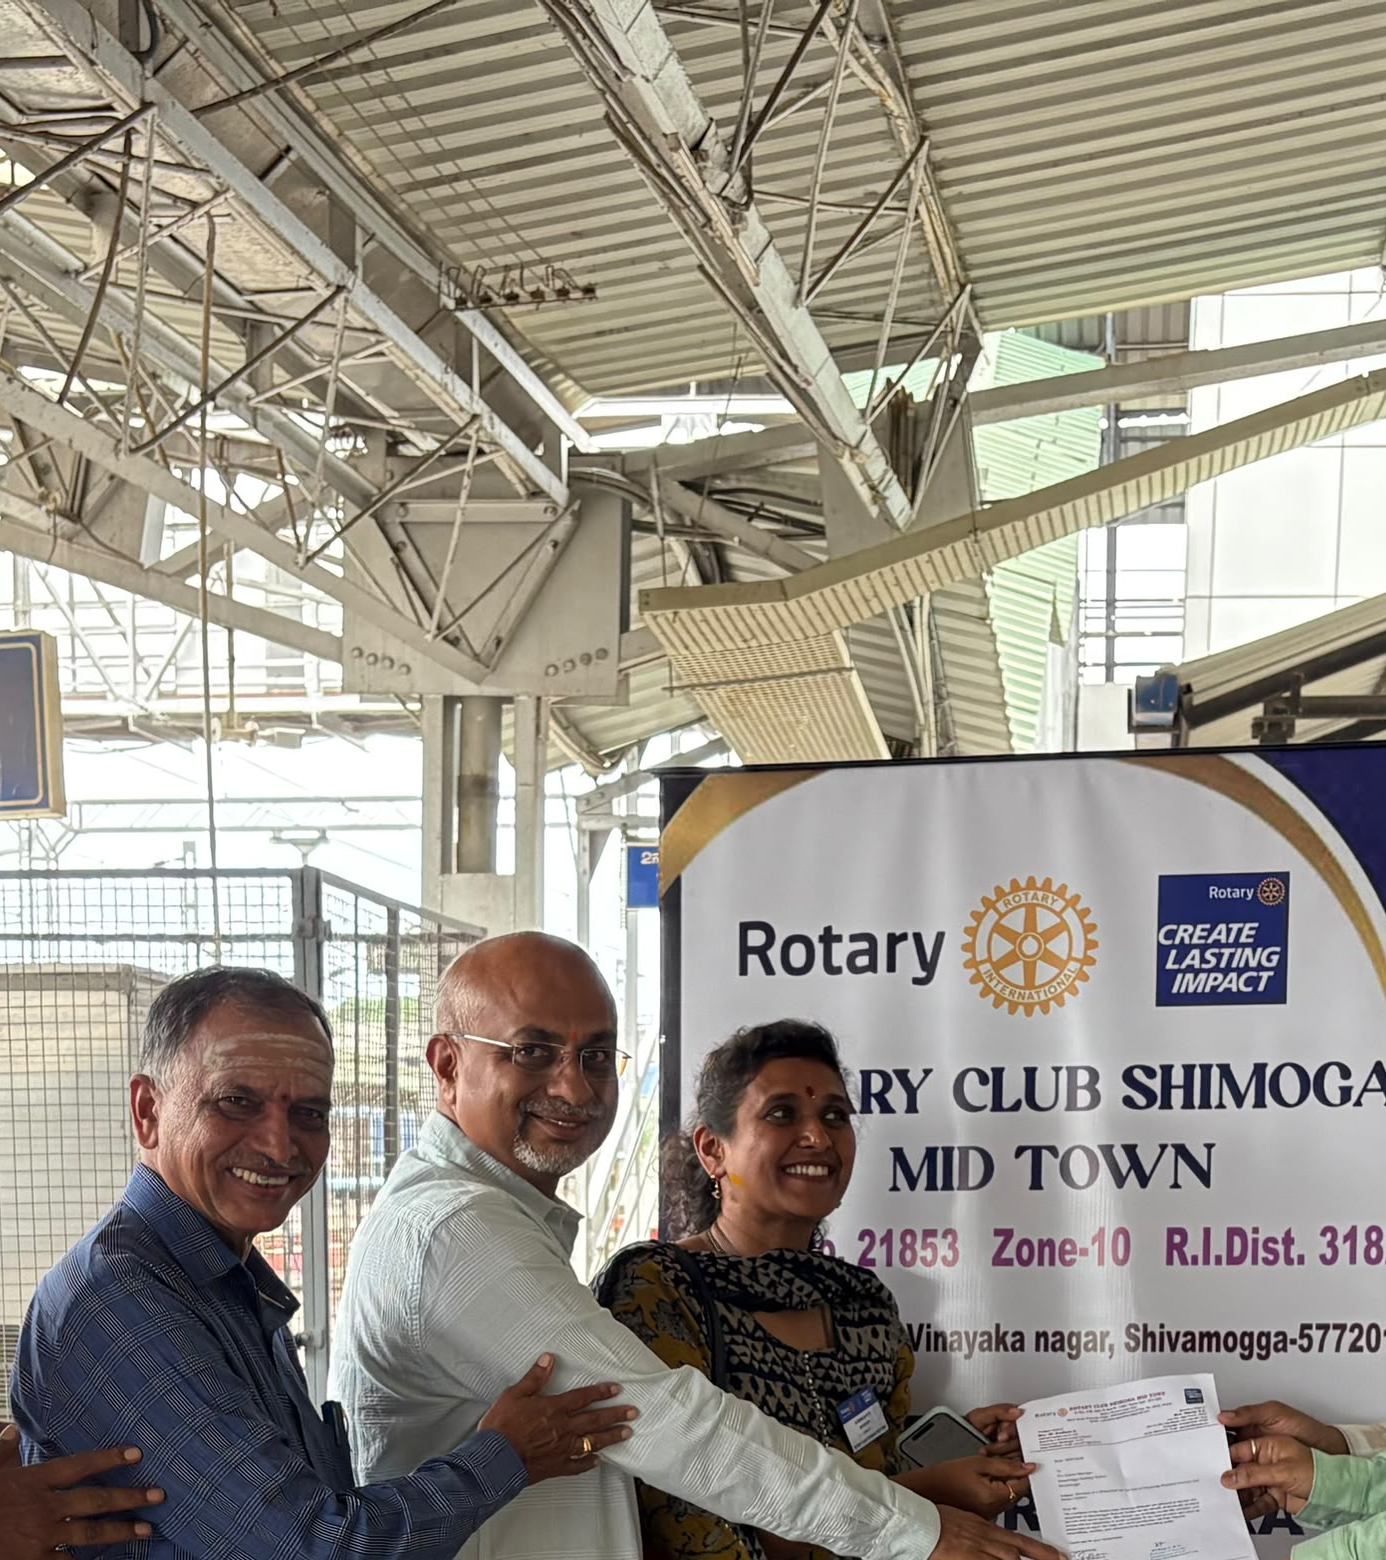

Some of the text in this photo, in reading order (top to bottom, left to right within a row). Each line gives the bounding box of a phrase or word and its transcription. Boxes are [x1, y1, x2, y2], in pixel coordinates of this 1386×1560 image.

[1002, 891, 1059, 909] ROTARY
[1209, 886, 1254, 900] Rotary
[1158, 922, 1259, 946] CREATE
[737, 920, 946, 987] Rotary
[1165, 946, 1281, 970] LASTING
[983, 967, 1078, 1001] INTERNATIONAL
[1171, 971, 1275, 994] IMPACT
[953, 1065, 1102, 1115] CLUB
[888, 1143, 1218, 1194] MID TOWN
[857, 1227, 960, 1268] 21853
[991, 1226, 1132, 1268] Zone-10
[1165, 1226, 1306, 1267] R.I.Dist.
[907, 1322, 1026, 1361] Vinayaka
[1034, 1328, 1115, 1361] nagar,
